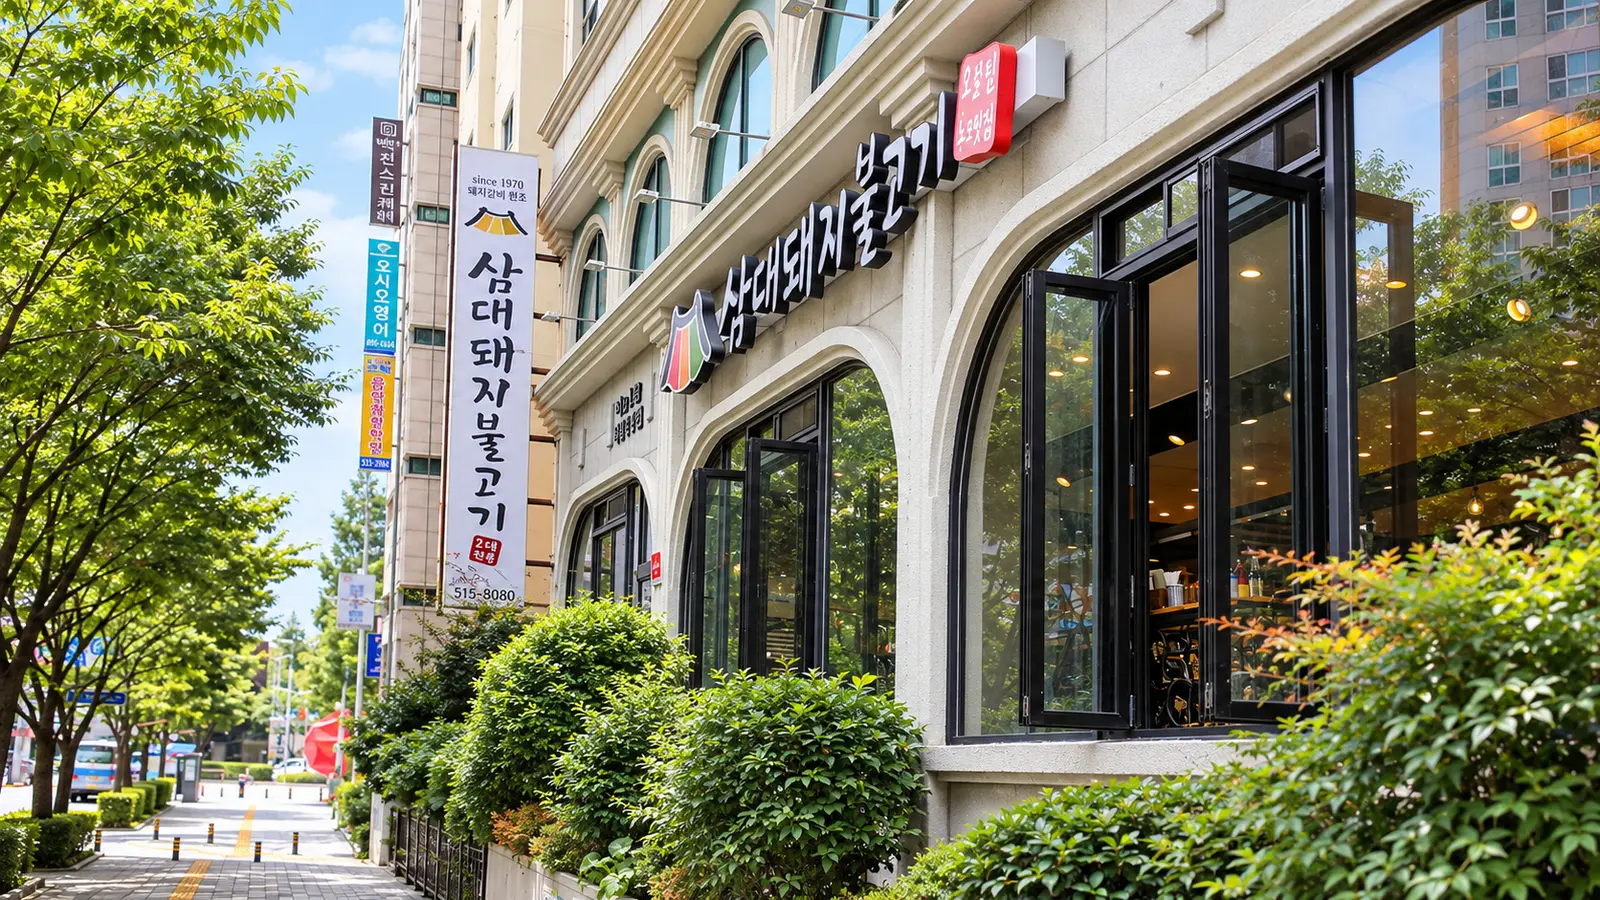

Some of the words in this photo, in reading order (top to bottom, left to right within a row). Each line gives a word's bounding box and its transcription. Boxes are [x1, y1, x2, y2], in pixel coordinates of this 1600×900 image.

[472, 174, 497, 187] since
[502, 178, 524, 190] 1970
[719, 90, 955, 353] 삼대돼지불고기
[373, 259, 391, 338] 오시오영어
[468, 252, 523, 531] 삼대돼지불고기
[454, 587, 515, 601] 515-8080
